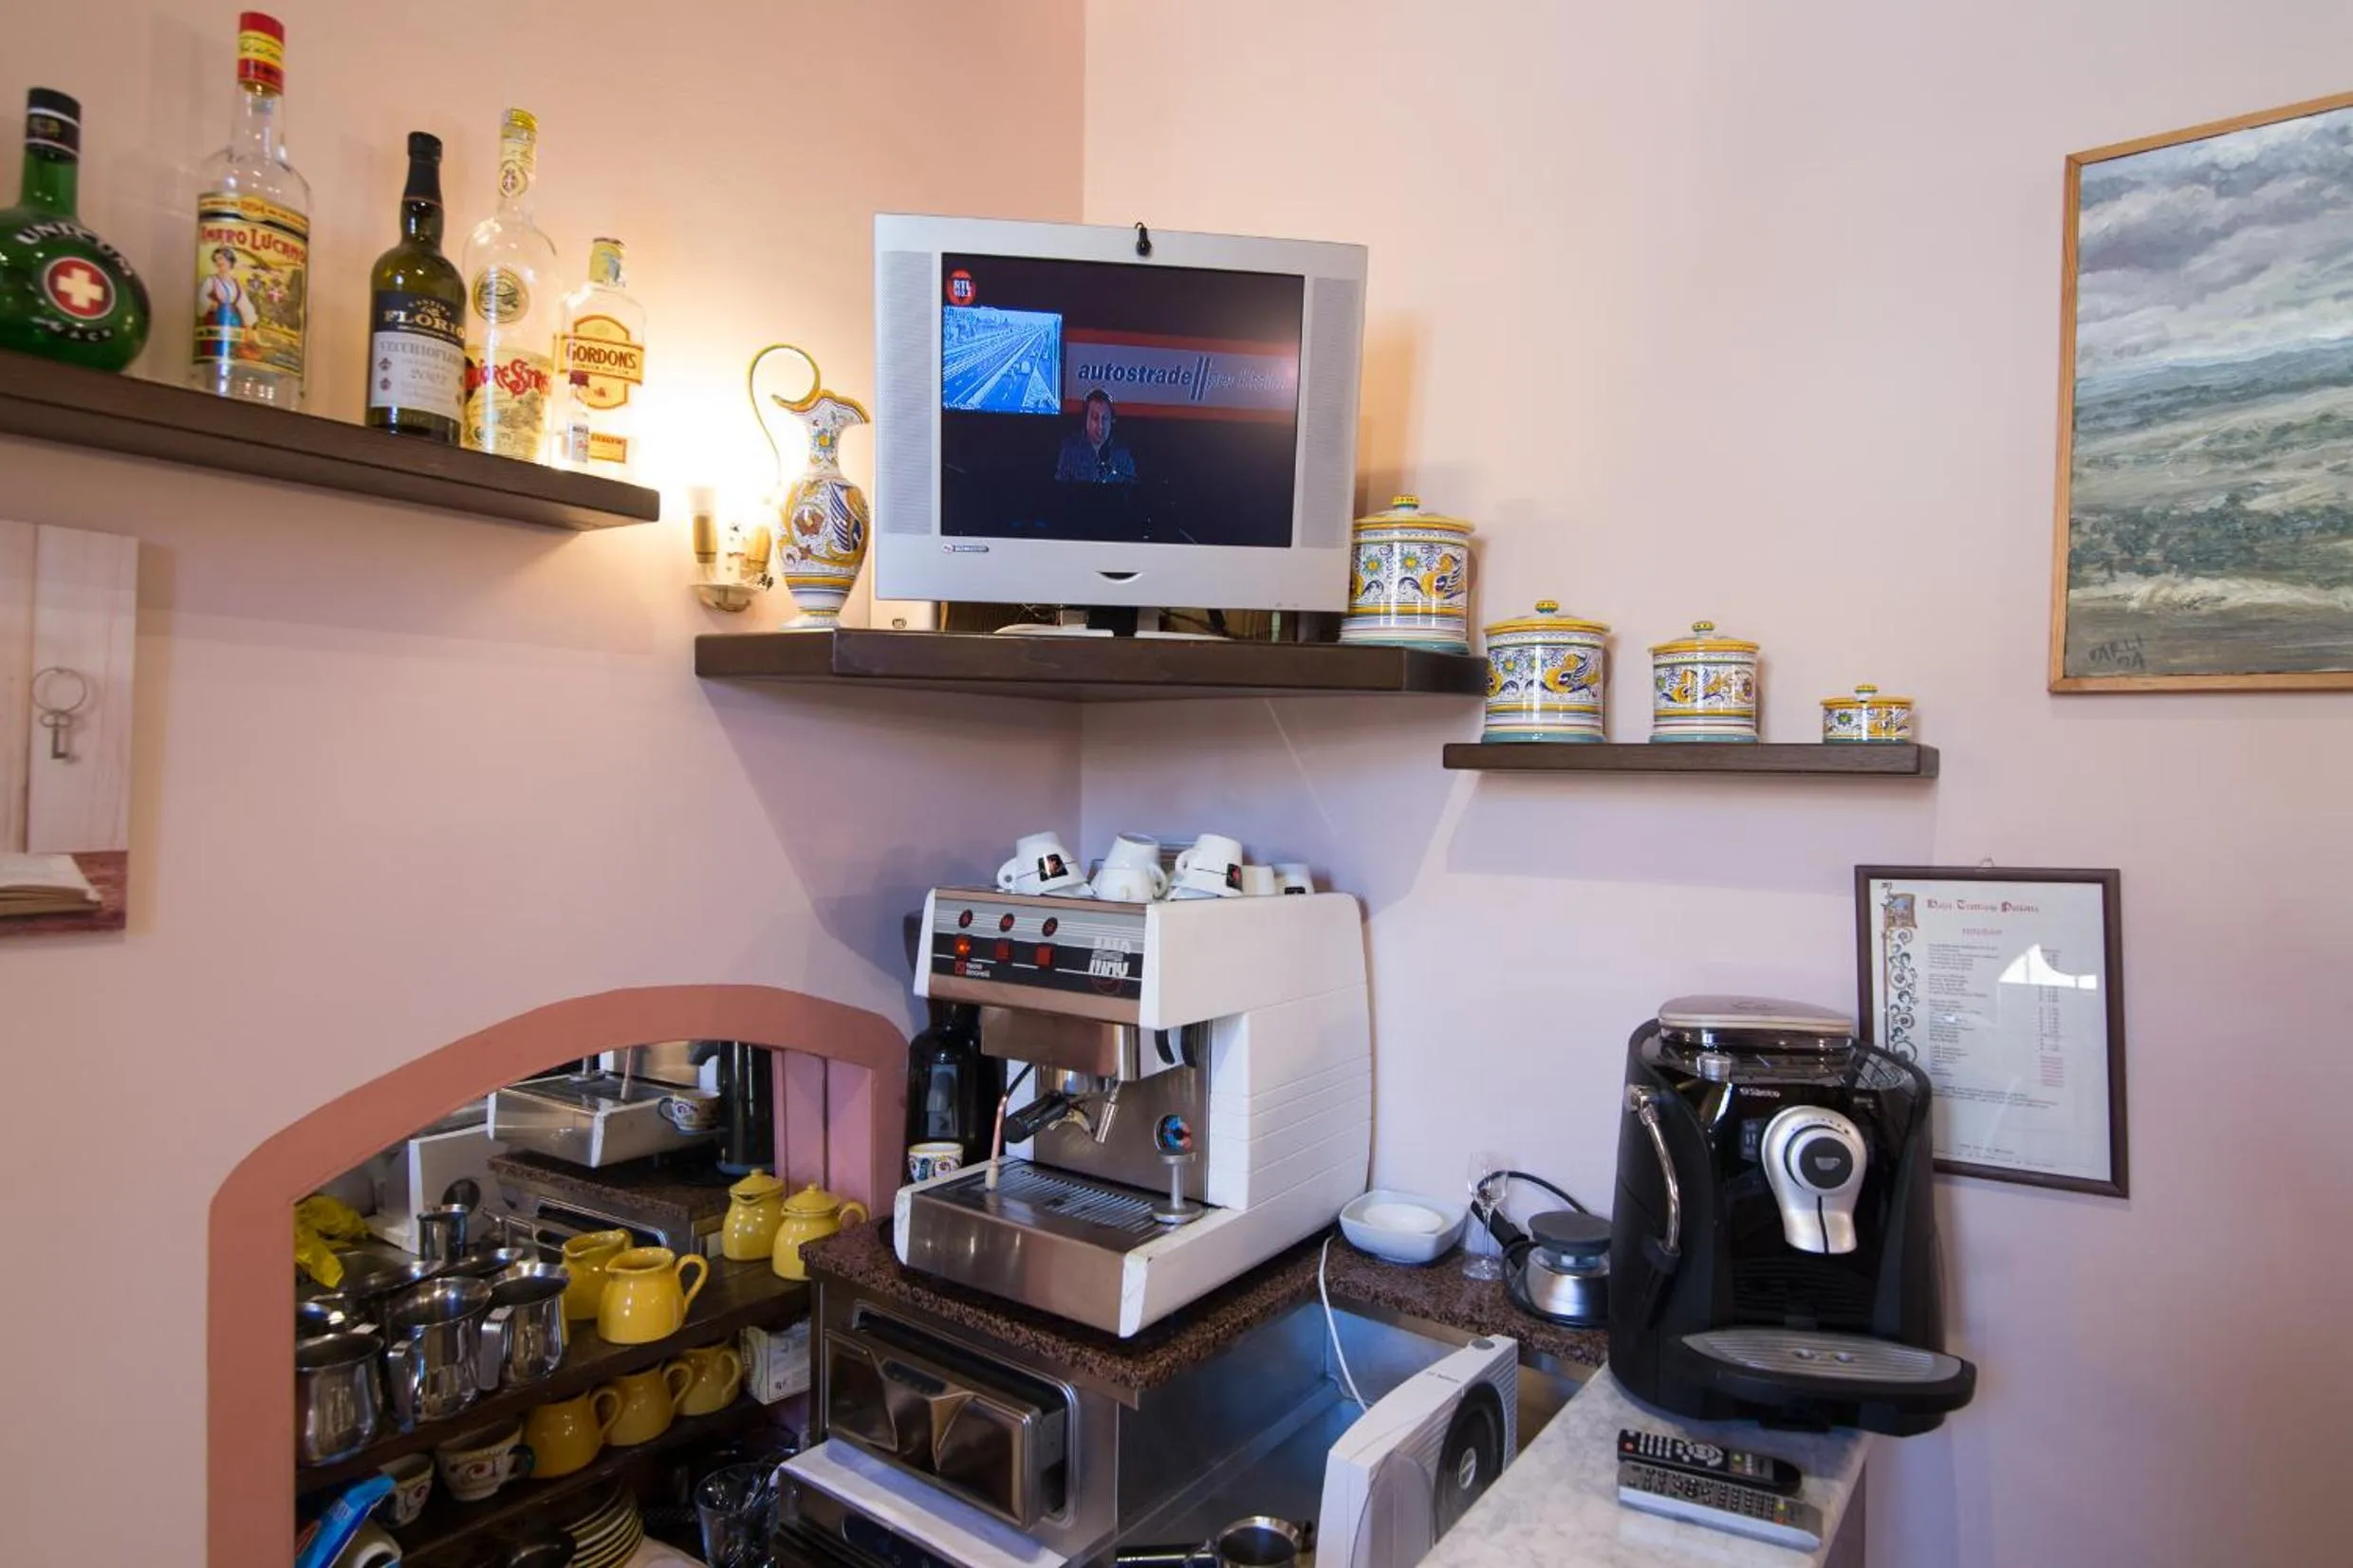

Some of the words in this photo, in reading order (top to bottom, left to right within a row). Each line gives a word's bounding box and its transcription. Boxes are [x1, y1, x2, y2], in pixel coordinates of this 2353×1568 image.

[383, 308, 466, 340] FLORIO
[565, 341, 637, 371] GORDON'S
[1078, 362, 1193, 387] autostrade
